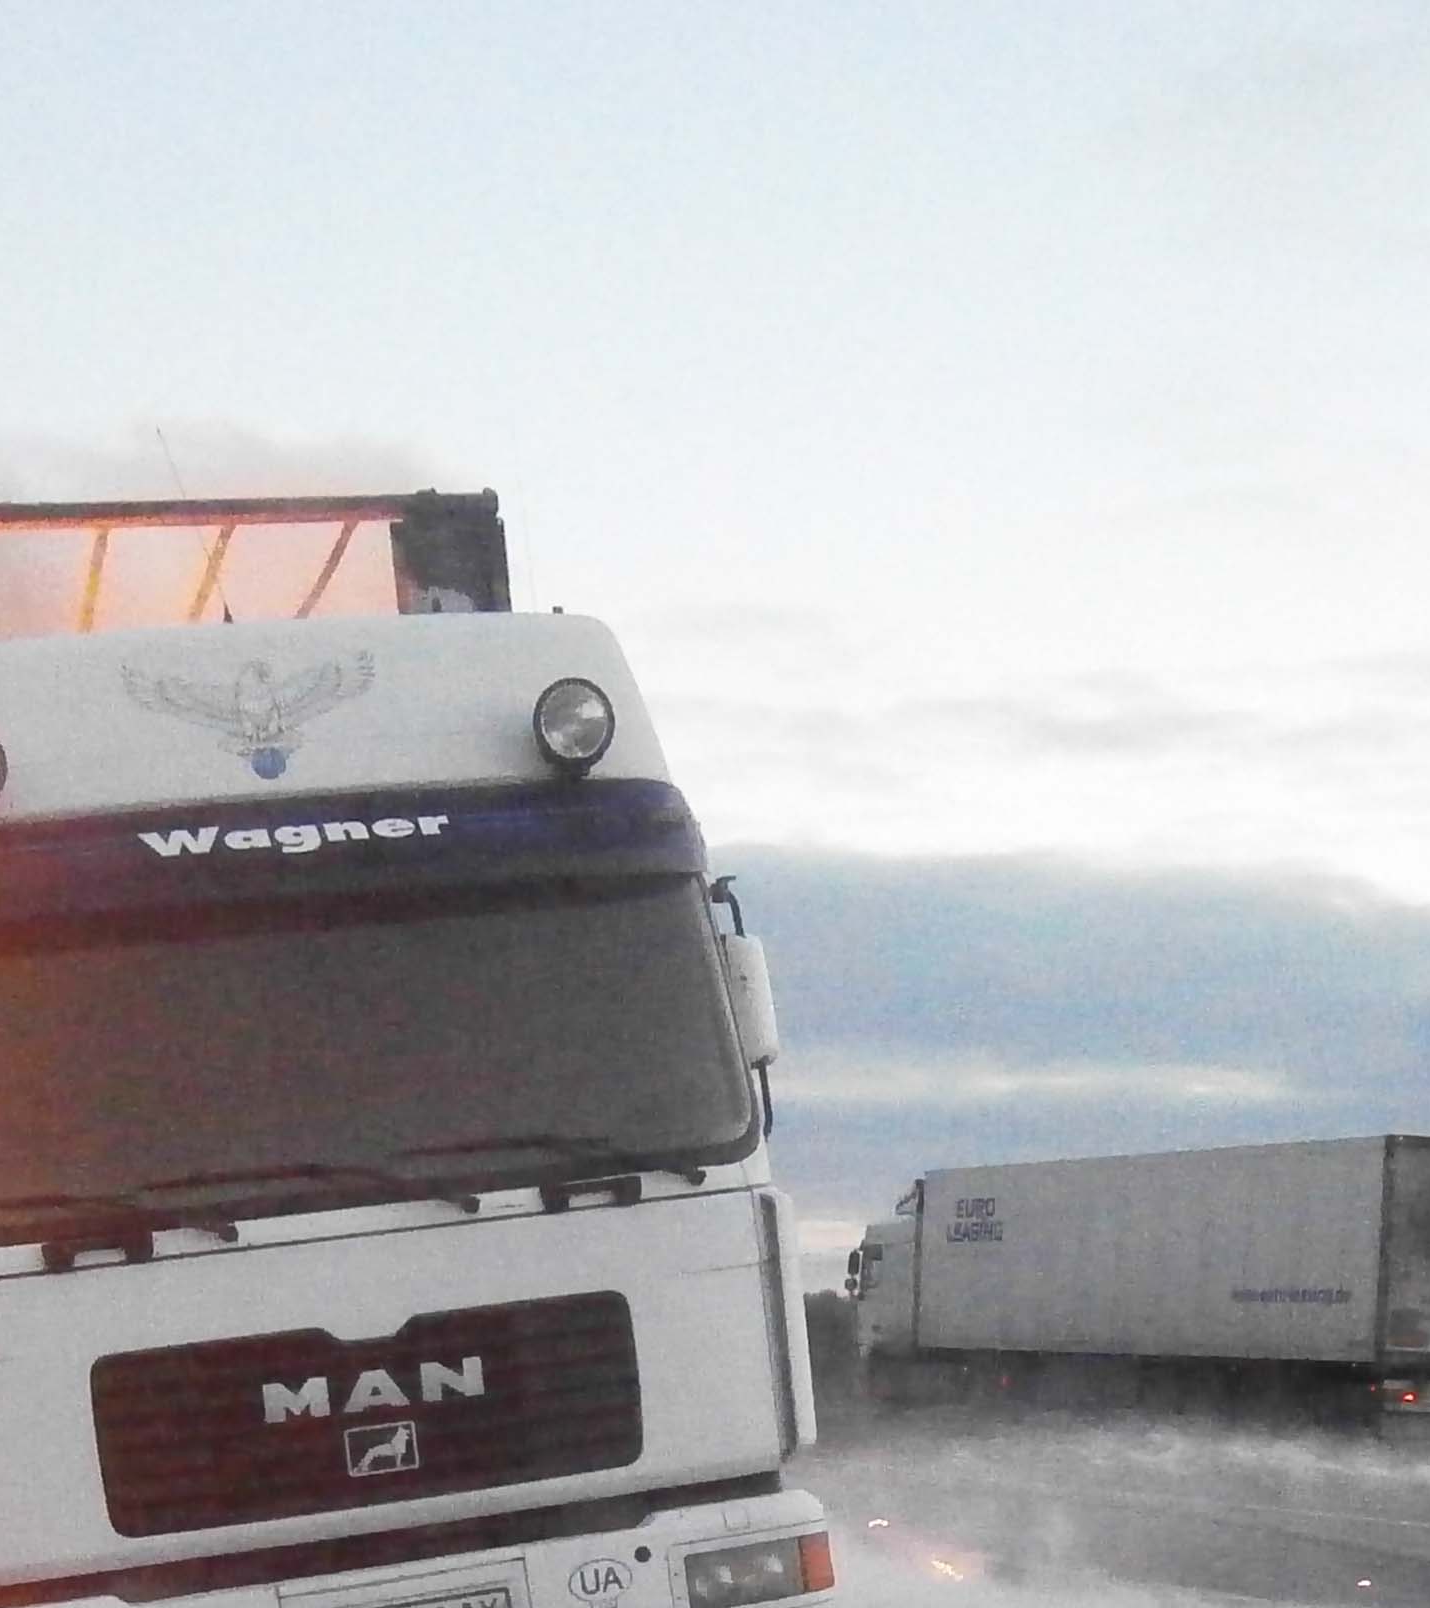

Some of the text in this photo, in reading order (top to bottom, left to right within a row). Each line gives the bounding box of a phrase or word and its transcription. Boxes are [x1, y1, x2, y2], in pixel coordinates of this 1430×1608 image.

[137, 815, 448, 857] Wagner
[955, 1197, 996, 1218] EURO
[263, 1356, 485, 1423] MAN
[580, 1566, 624, 1595] UA
